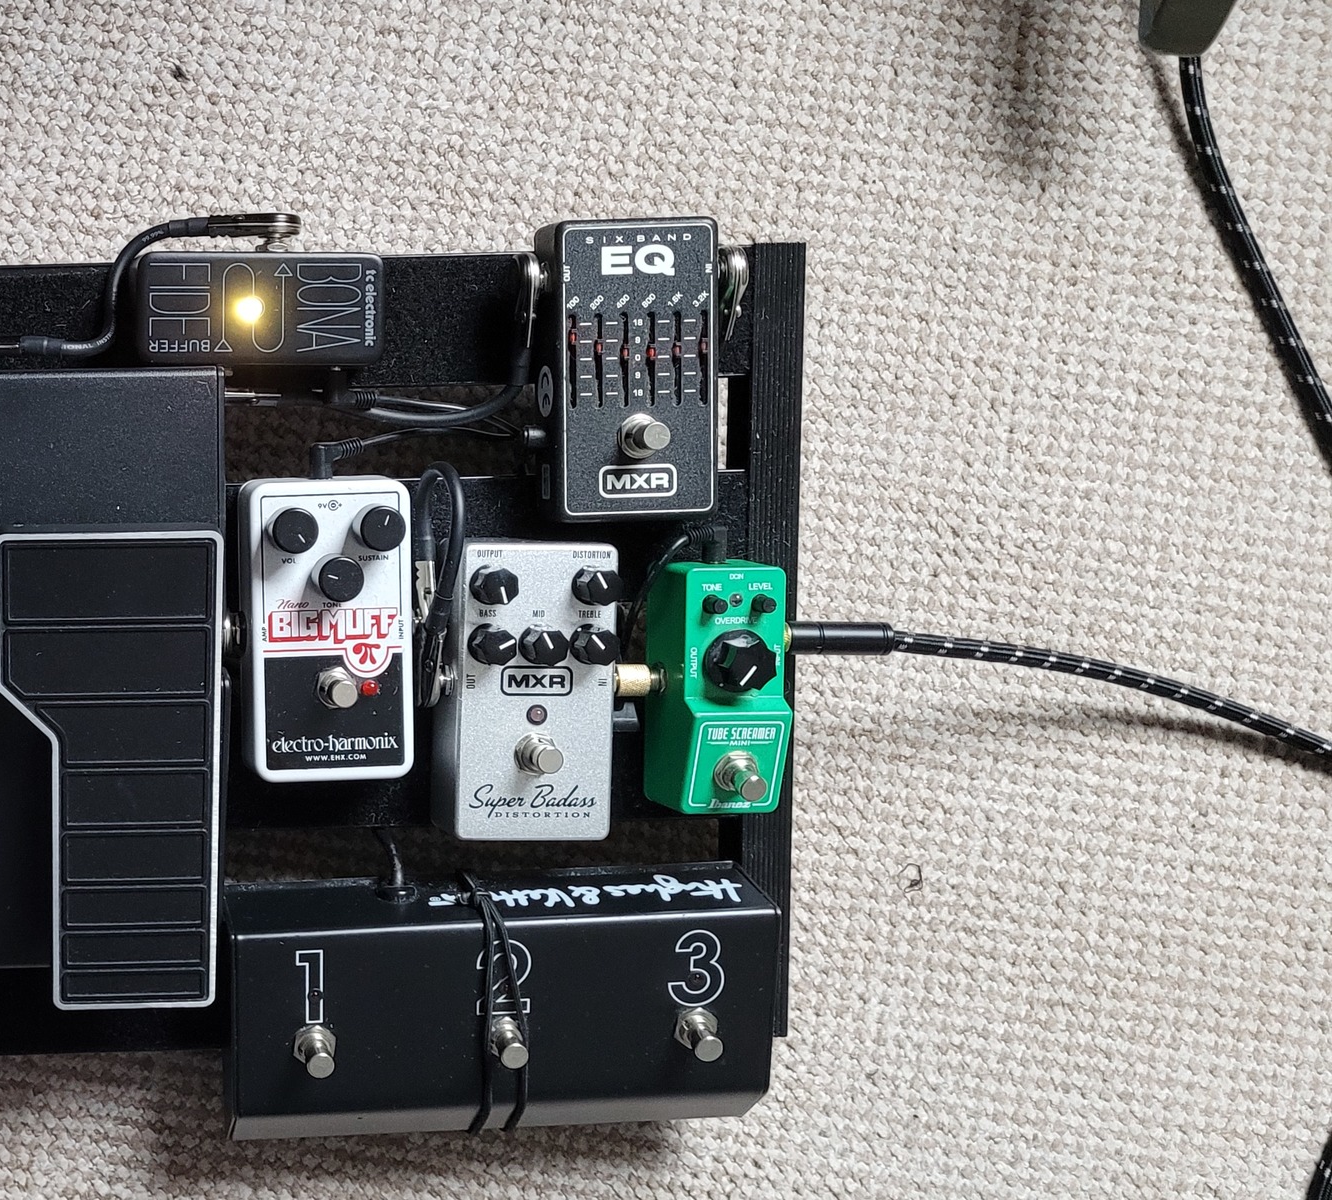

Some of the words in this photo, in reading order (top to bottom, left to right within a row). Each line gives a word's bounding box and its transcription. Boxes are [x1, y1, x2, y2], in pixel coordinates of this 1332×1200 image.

[586, 236, 624, 244] SIX
[637, 233, 692, 243] BAND
[601, 244, 675, 276] EQ
[705, 263, 713, 273] IN
[365, 269, 377, 282] tc
[563, 265, 571, 282] OUT
[149, 263, 210, 337] FIDE
[297, 263, 362, 352] BONA
[567, 295, 580, 310] 100
[589, 295, 604, 310] 200
[616, 294, 630, 309] 400
[641, 293, 656, 308] 800
[692, 290, 709, 307] 3.2K
[365, 283, 377, 347] electronic
[149, 340, 210, 352] BUFFER
[606, 473, 669, 490] MXR
[477, 550, 503, 558] OUTPUT
[572, 551, 611, 559] DISTORTION
[701, 583, 723, 592] TONE
[748, 583, 773, 591] LEVEL
[275, 599, 309, 609] Nano
[533, 610, 545, 618] MID
[578, 610, 602, 619] TREBLE
[268, 610, 320, 642] BIG
[319, 607, 398, 644] MUFF
[690, 647, 698, 679] OUTPUT
[466, 674, 476, 690] OUT
[508, 674, 566, 689] MXR
[598, 678, 608, 687] IN
[707, 728, 729, 740] TUBE
[731, 727, 776, 740] SCREAMER
[272, 732, 399, 754] electro-harmonix
[305, 754, 367, 762] WWW.EHX.COM
[469, 783, 527, 819] Super
[530, 784, 597, 809] Badass
[708, 798, 751, 808] Ibanez
[568, 885, 600, 905] &
[602, 874, 742, 902] Hughes
[668, 929, 725, 1007] 3
[476, 939, 532, 1015] 2
[295, 949, 324, 1024] 1
